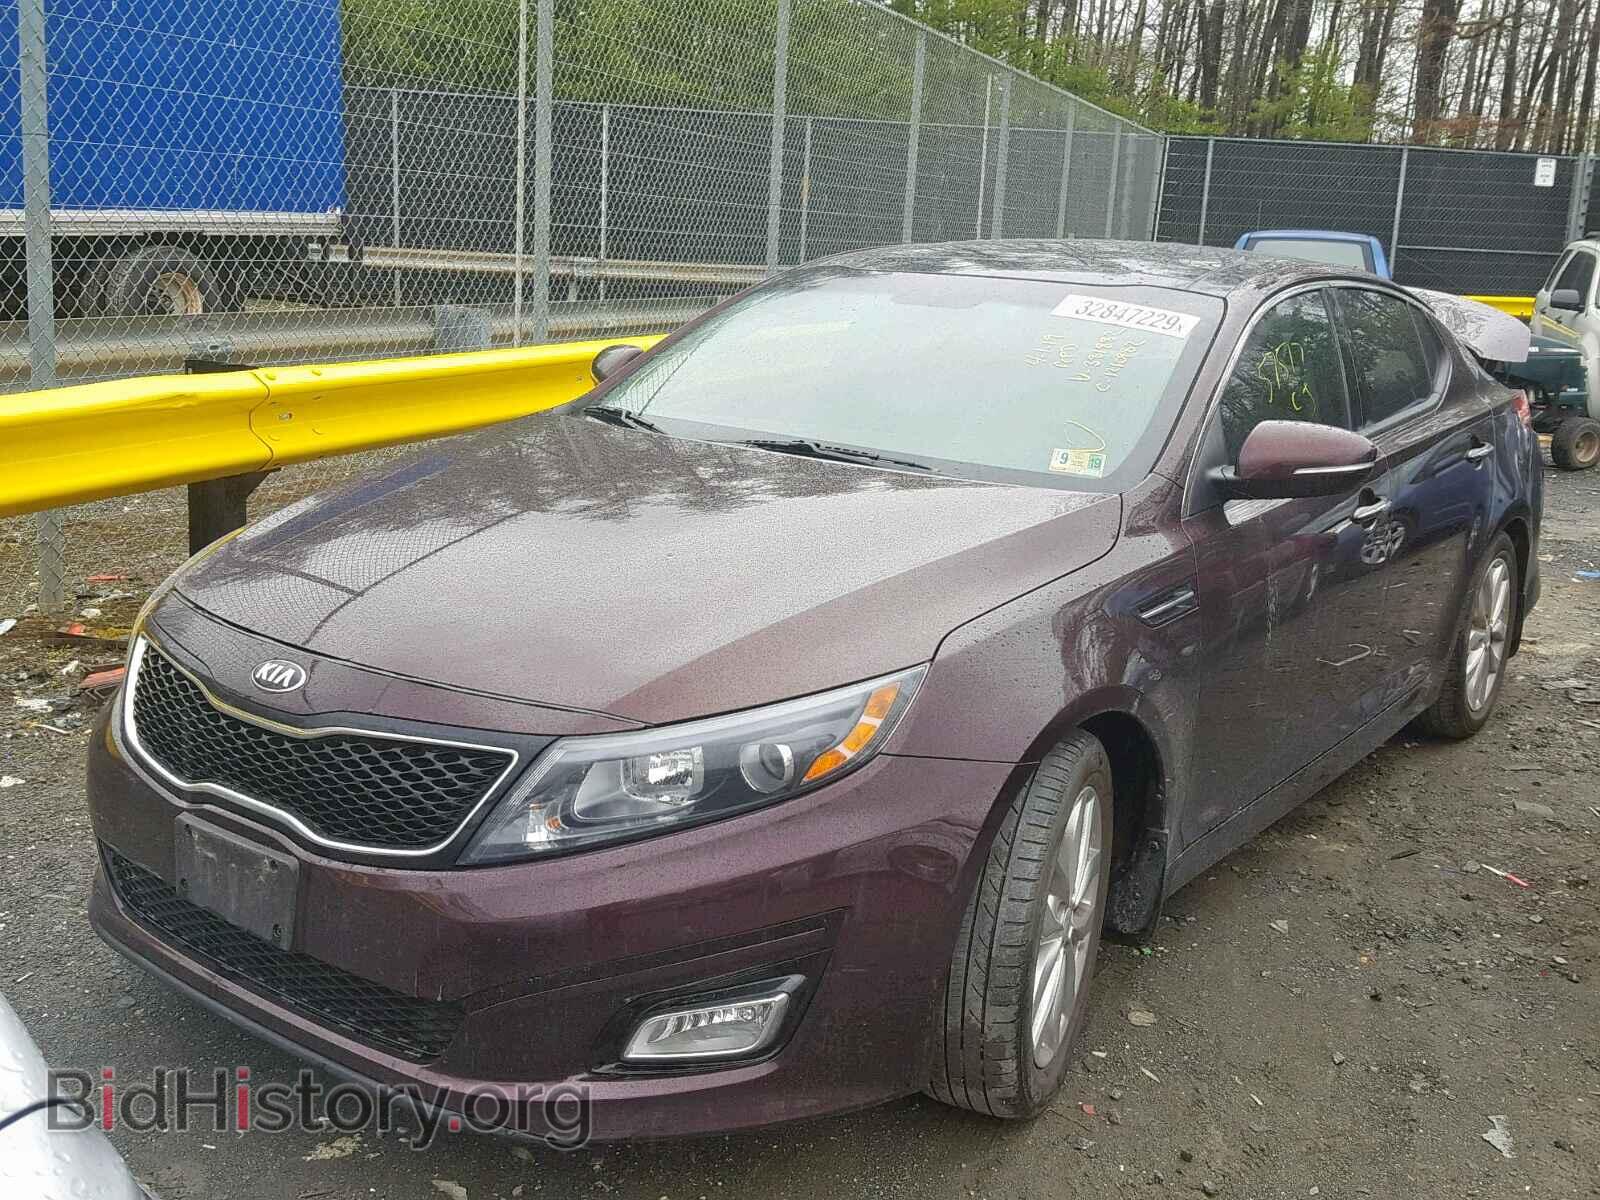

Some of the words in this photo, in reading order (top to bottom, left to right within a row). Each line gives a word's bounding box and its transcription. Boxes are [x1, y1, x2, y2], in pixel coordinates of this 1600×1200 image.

[1059, 452, 1068, 464] 9
[1090, 457, 1102, 469] 19
[256, 663, 295, 687] KIA
